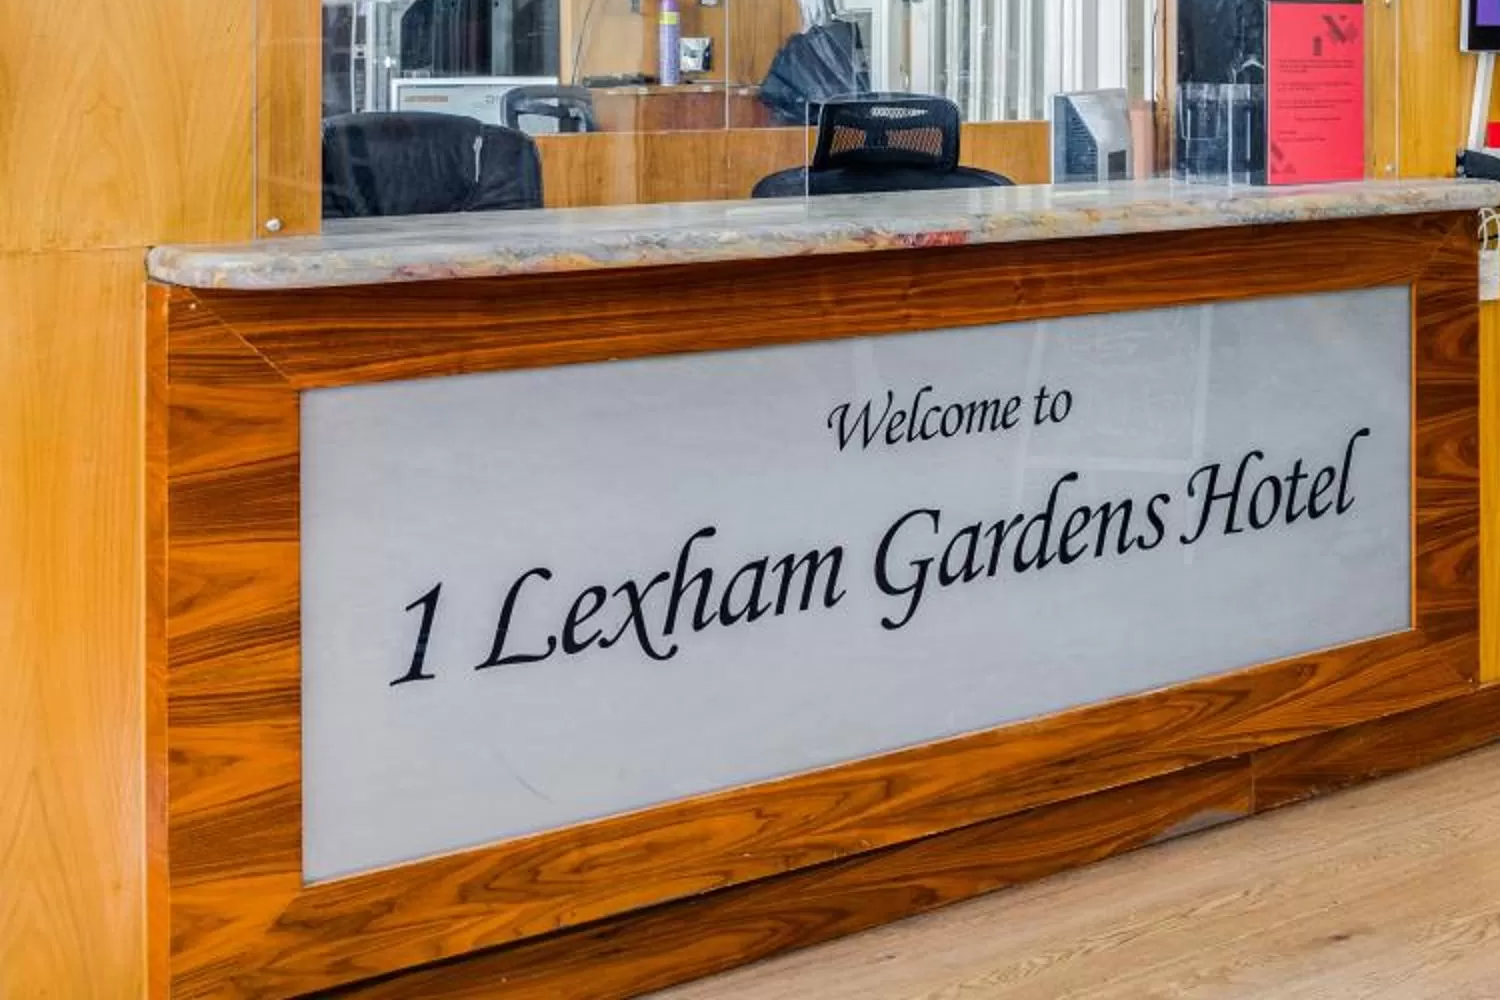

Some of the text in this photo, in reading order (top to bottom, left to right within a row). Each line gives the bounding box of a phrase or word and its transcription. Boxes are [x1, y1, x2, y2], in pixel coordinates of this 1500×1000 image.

[827, 385, 1072, 452] Welcome to
[390, 427, 1371, 687] 1 Lexham Gardens Hotel
